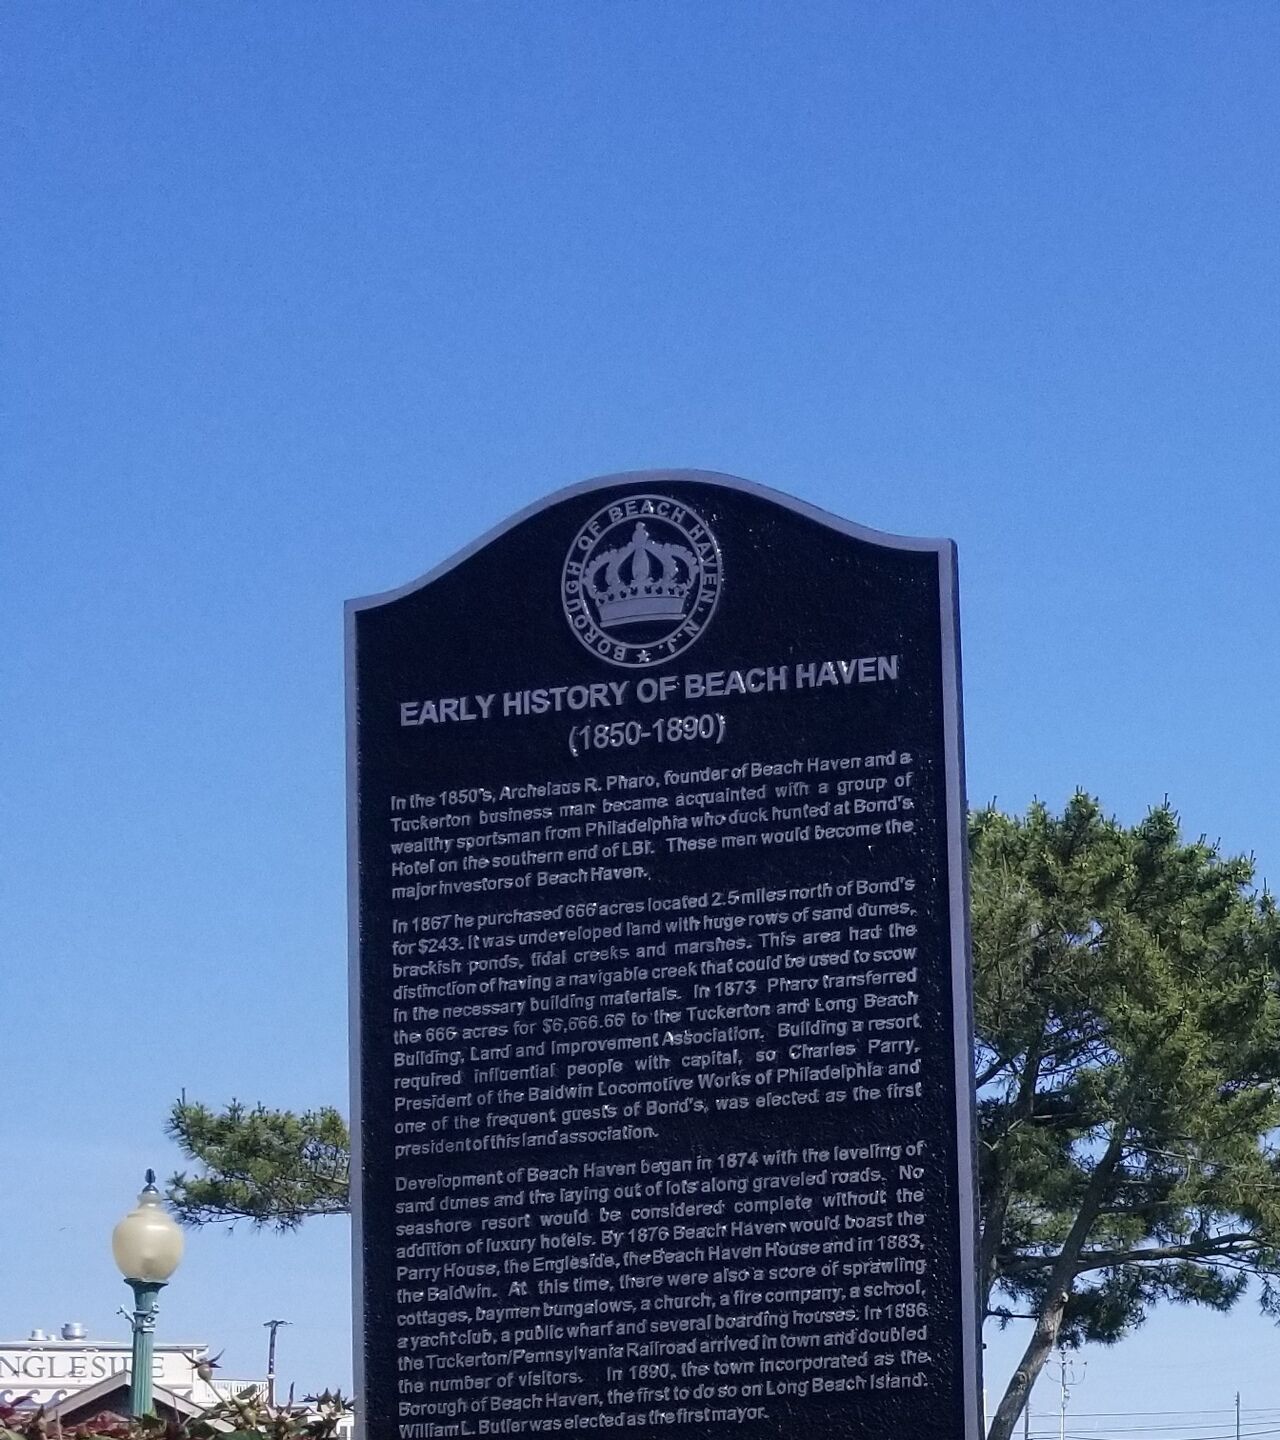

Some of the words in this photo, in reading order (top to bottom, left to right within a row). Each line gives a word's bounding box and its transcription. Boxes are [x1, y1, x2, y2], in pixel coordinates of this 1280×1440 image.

[578, 520, 602, 551] OF
[608, 500, 686, 523] BEACH
[565, 562, 627, 661] BOROUGH
[658, 619, 700, 654] N.J.
[400, 693, 496, 727] EARLY
[503, 681, 629, 717] HISTORY
[636, 675, 680, 705] OF
[685, 664, 787, 698] BEACH
[796, 654, 899, 688] HAVEN
[568, 711, 727, 757] (1850-1890)
[390, 814, 471, 832] Tuckerton
[479, 807, 553, 825] business
[559, 803, 596, 817] man
[602, 796, 669, 813] became
[675, 784, 766, 808] acquainted
[774, 781, 809, 798] with
[818, 782, 829, 794] a
[837, 777, 888, 796] group
[894, 771, 914, 787] of
[391, 795, 407, 811] In
[409, 793, 436, 809] the
[439, 787, 496, 806] 1850's,
[499, 781, 581, 801] Archelaus
[584, 777, 602, 793] R.
[606, 775, 660, 791] Pharo,
[663, 767, 730, 785] founder
[730, 762, 750, 779] of
[750, 759, 804, 778] Beach
[807, 757, 862, 772] Haven
[864, 750, 897, 768] and
[899, 752, 913, 764] a
[390, 836, 454, 854] wealthy
[456, 830, 541, 851] sportsman
[544, 825, 581, 841] from
[585, 815, 688, 837] Philadelphia
[690, 811, 727, 828] who
[728, 807, 769, 825] duck
[772, 801, 831, 821] hunted
[833, 800, 851, 816] at
[853, 795, 915, 814] Bond's
[391, 858, 436, 877] Hotel
[438, 860, 458, 873] on
[462, 855, 491, 870] the
[492, 850, 564, 868] southern
[567, 844, 598, 861] end
[601, 842, 620, 858] of
[622, 839, 655, 857] LBI.
[665, 837, 718, 853] These
[721, 834, 757, 848] men
[760, 825, 810, 845] would
[814, 823, 883, 840] become
[884, 818, 918, 834] the
[392, 883, 438, 901] major
[439, 877, 514, 895] investors
[514, 872, 532, 888] of
[537, 868, 588, 887] Beach
[590, 866, 649, 882] Haven.
[392, 959, 462, 978] brackish
[467, 954, 524, 975] ponds,
[531, 949, 567, 967] tidal
[573, 945, 630, 963] creeks
[636, 941, 666, 958] and
[674, 937, 753, 955] marshes.
[758, 931, 796, 948] This
[802, 930, 841, 945] area
[848, 924, 883, 941] had
[888, 922, 918, 938] the
[393, 1007, 408, 1023] in
[412, 1006, 439, 1021] the
[443, 1001, 526, 1018] necessary
[530, 993, 596, 1012] building
[599, 986, 682, 1006] materials.
[693, 984, 711, 999] In
[714, 979, 757, 997] 1873
[767, 977, 820, 993] Pharo
[822, 967, 918, 989] transferred
[393, 1029, 422, 1045] the
[425, 1026, 458, 1042] 666
[462, 1025, 509, 1039] acres
[513, 1020, 537, 1035] for
[631, 1011, 648, 1026] to
[650, 1009, 682, 1024] the
[686, 1003, 771, 1021] Tuckerton
[776, 998, 810, 1015] and
[814, 997, 858, 1013] Long
[863, 990, 919, 1008] Beach
[393, 1049, 465, 1067] Building,
[470, 1044, 512, 1061] Land
[515, 1041, 545, 1058] and
[551, 1033, 659, 1056] Improvement
[661, 1026, 765, 1046] Association.
[777, 1019, 848, 1038] Building
[851, 1020, 865, 1032] a
[868, 1013, 922, 1031] resort
[394, 1070, 462, 1091] required
[474, 1062, 556, 1083] influential
[567, 1058, 623, 1080] people
[634, 1054, 671, 1071] with
[681, 1048, 743, 1070] capital,
[755, 1049, 778, 1062] so
[788, 1042, 856, 1060] Charles
[868, 1038, 921, 1055] Parry,
[394, 1093, 472, 1112] President
[476, 1090, 494, 1106] of
[497, 1088, 525, 1104] the
[528, 1083, 593, 1102] Baldwin
[598, 1076, 694, 1096] Locomotive
[697, 1071, 752, 1089] Works
[754, 1068, 773, 1085] of
[777, 1061, 884, 1083] Philadelphia
[888, 1058, 922, 1076] and
[395, 1170, 504, 1191] Development
[506, 1167, 526, 1184] of
[527, 1164, 579, 1182] Beach
[583, 1162, 636, 1178] Haven
[640, 1159, 692, 1176] began
[696, 1155, 712, 1170] in
[717, 1151, 759, 1169] 1874
[762, 1149, 798, 1166] with
[802, 1148, 830, 1163] the
[833, 1143, 903, 1161] leveling
[905, 1139, 925, 1157] of
[395, 1219, 472, 1236] seashore
[481, 1213, 531, 1230] resort
[540, 1208, 589, 1227] would
[599, 1206, 622, 1222] be
[630, 1199, 725, 1220] considered
[734, 1195, 813, 1215] complete
[822, 1189, 887, 1207] without
[896, 1187, 925, 1203] the
[397, 1356, 425, 1371] the
[426, 1344, 624, 1369] Tuckerton/Pennsylvania
[626, 1338, 697, 1357] Railroad
[700, 1334, 760, 1353] arrived
[761, 1333, 777, 1350] in
[780, 1334, 821, 1349] town
[823, 1327, 859, 1346] and
[858, 1325, 927, 1344] doubled
[398, 1378, 425, 1394] the
[430, 1375, 492, 1392] number
[496, 1372, 514, 1388] of
[518, 1370, 584, 1387] visitors.
[607, 1366, 623, 1382] In
[629, 1363, 677, 1380] 1890,
[681, 1360, 711, 1377] the
[713, 1361, 755, 1376] town
[760, 1351, 868, 1373] incorporated
[874, 1353, 895, 1366] as
[900, 1349, 931, 1365] the
